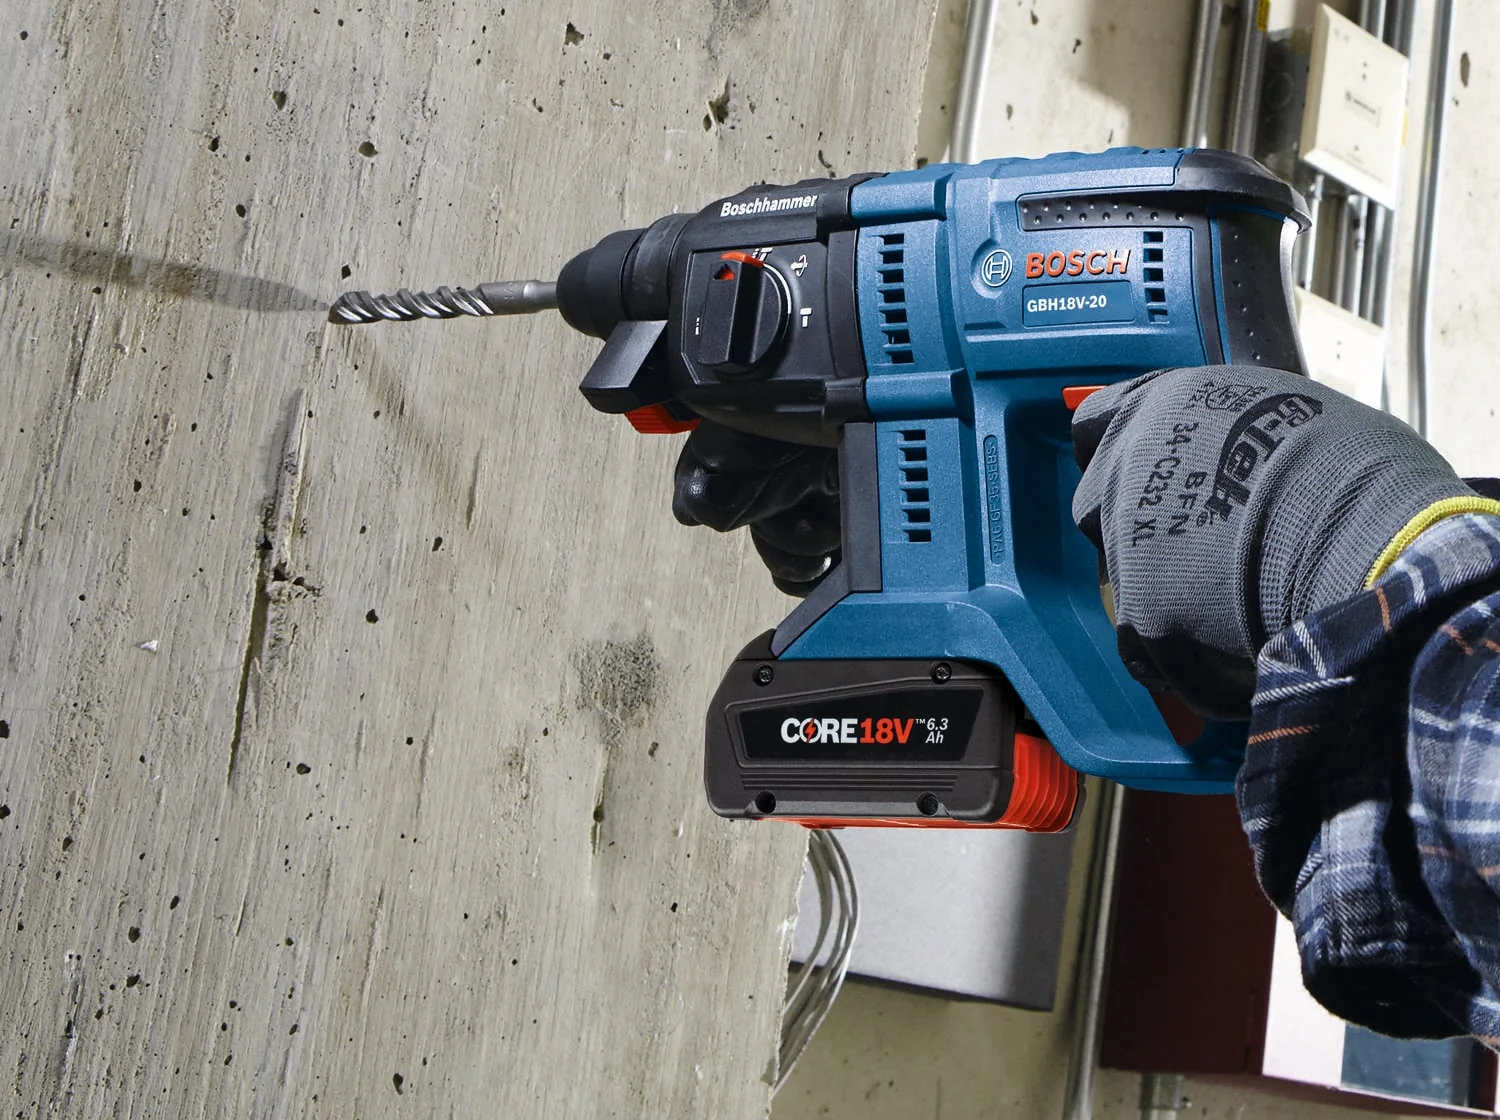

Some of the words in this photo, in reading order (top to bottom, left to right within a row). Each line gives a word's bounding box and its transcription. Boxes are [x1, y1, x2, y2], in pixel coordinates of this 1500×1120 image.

[720, 193, 818, 218] Boschhammer
[1025, 248, 1131, 279] BOSCH
[1026, 294, 1107, 314] GBH18V-20
[1138, 421, 1199, 509] 34-C232
[1132, 518, 1156, 547] XL
[926, 717, 949, 731] 6.3
[925, 732, 944, 745] Ah
